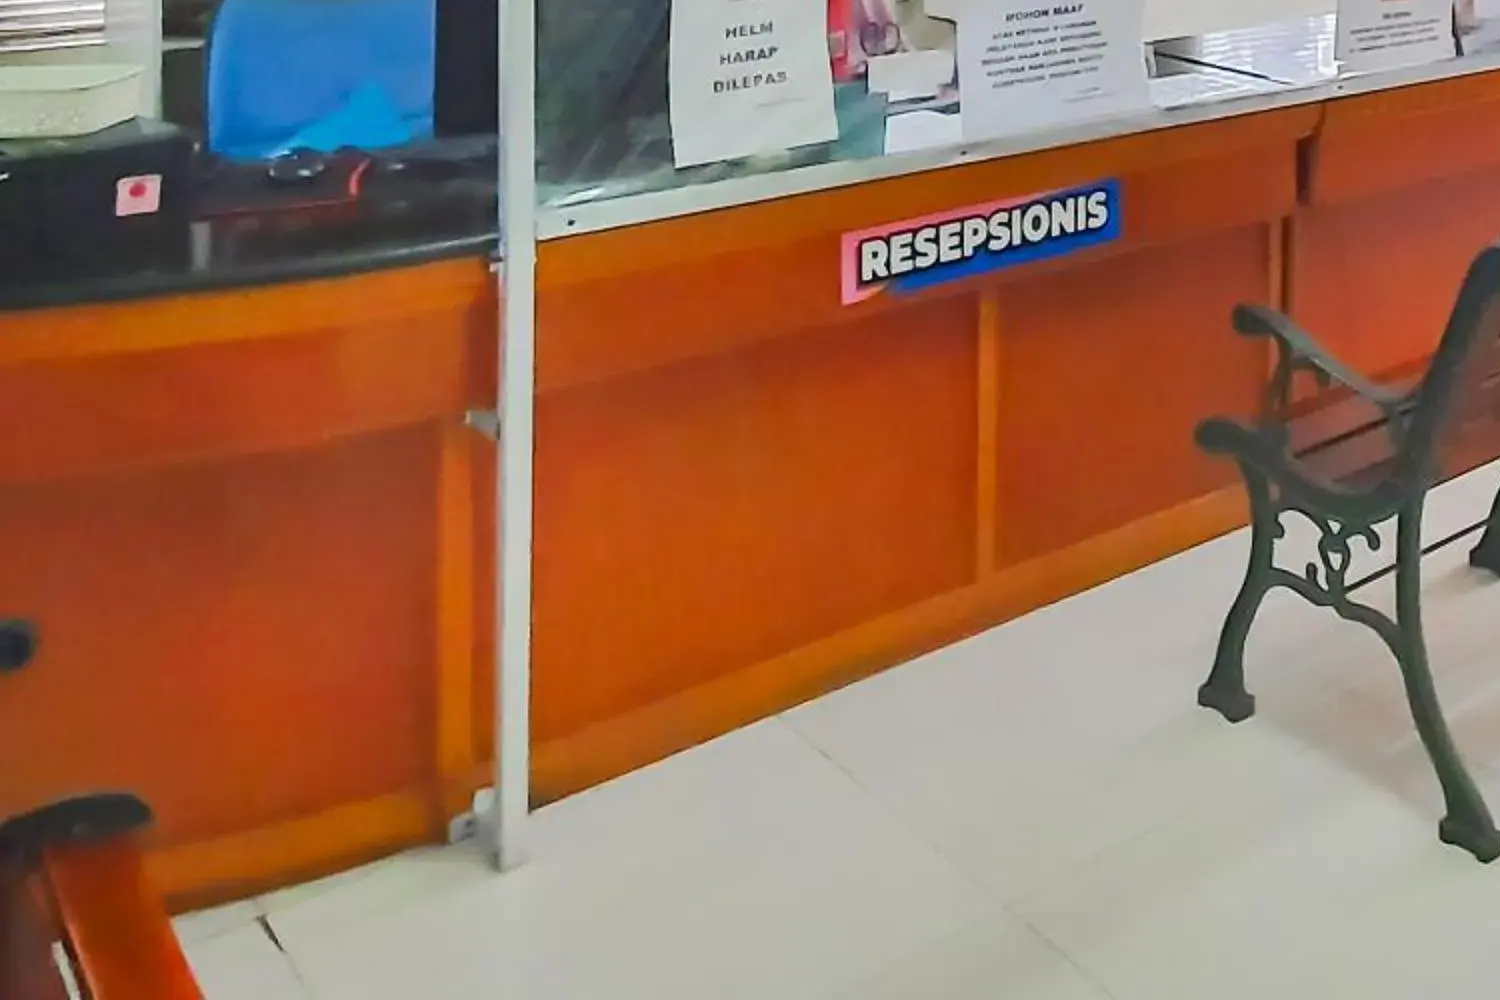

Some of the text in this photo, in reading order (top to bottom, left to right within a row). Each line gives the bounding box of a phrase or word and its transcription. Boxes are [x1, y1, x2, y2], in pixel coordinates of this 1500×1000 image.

[724, 20, 774, 39] HELM
[719, 46, 779, 66] HARAP
[713, 71, 788, 94] DILEPAS
[860, 190, 1109, 282] RESEPSIONIS
